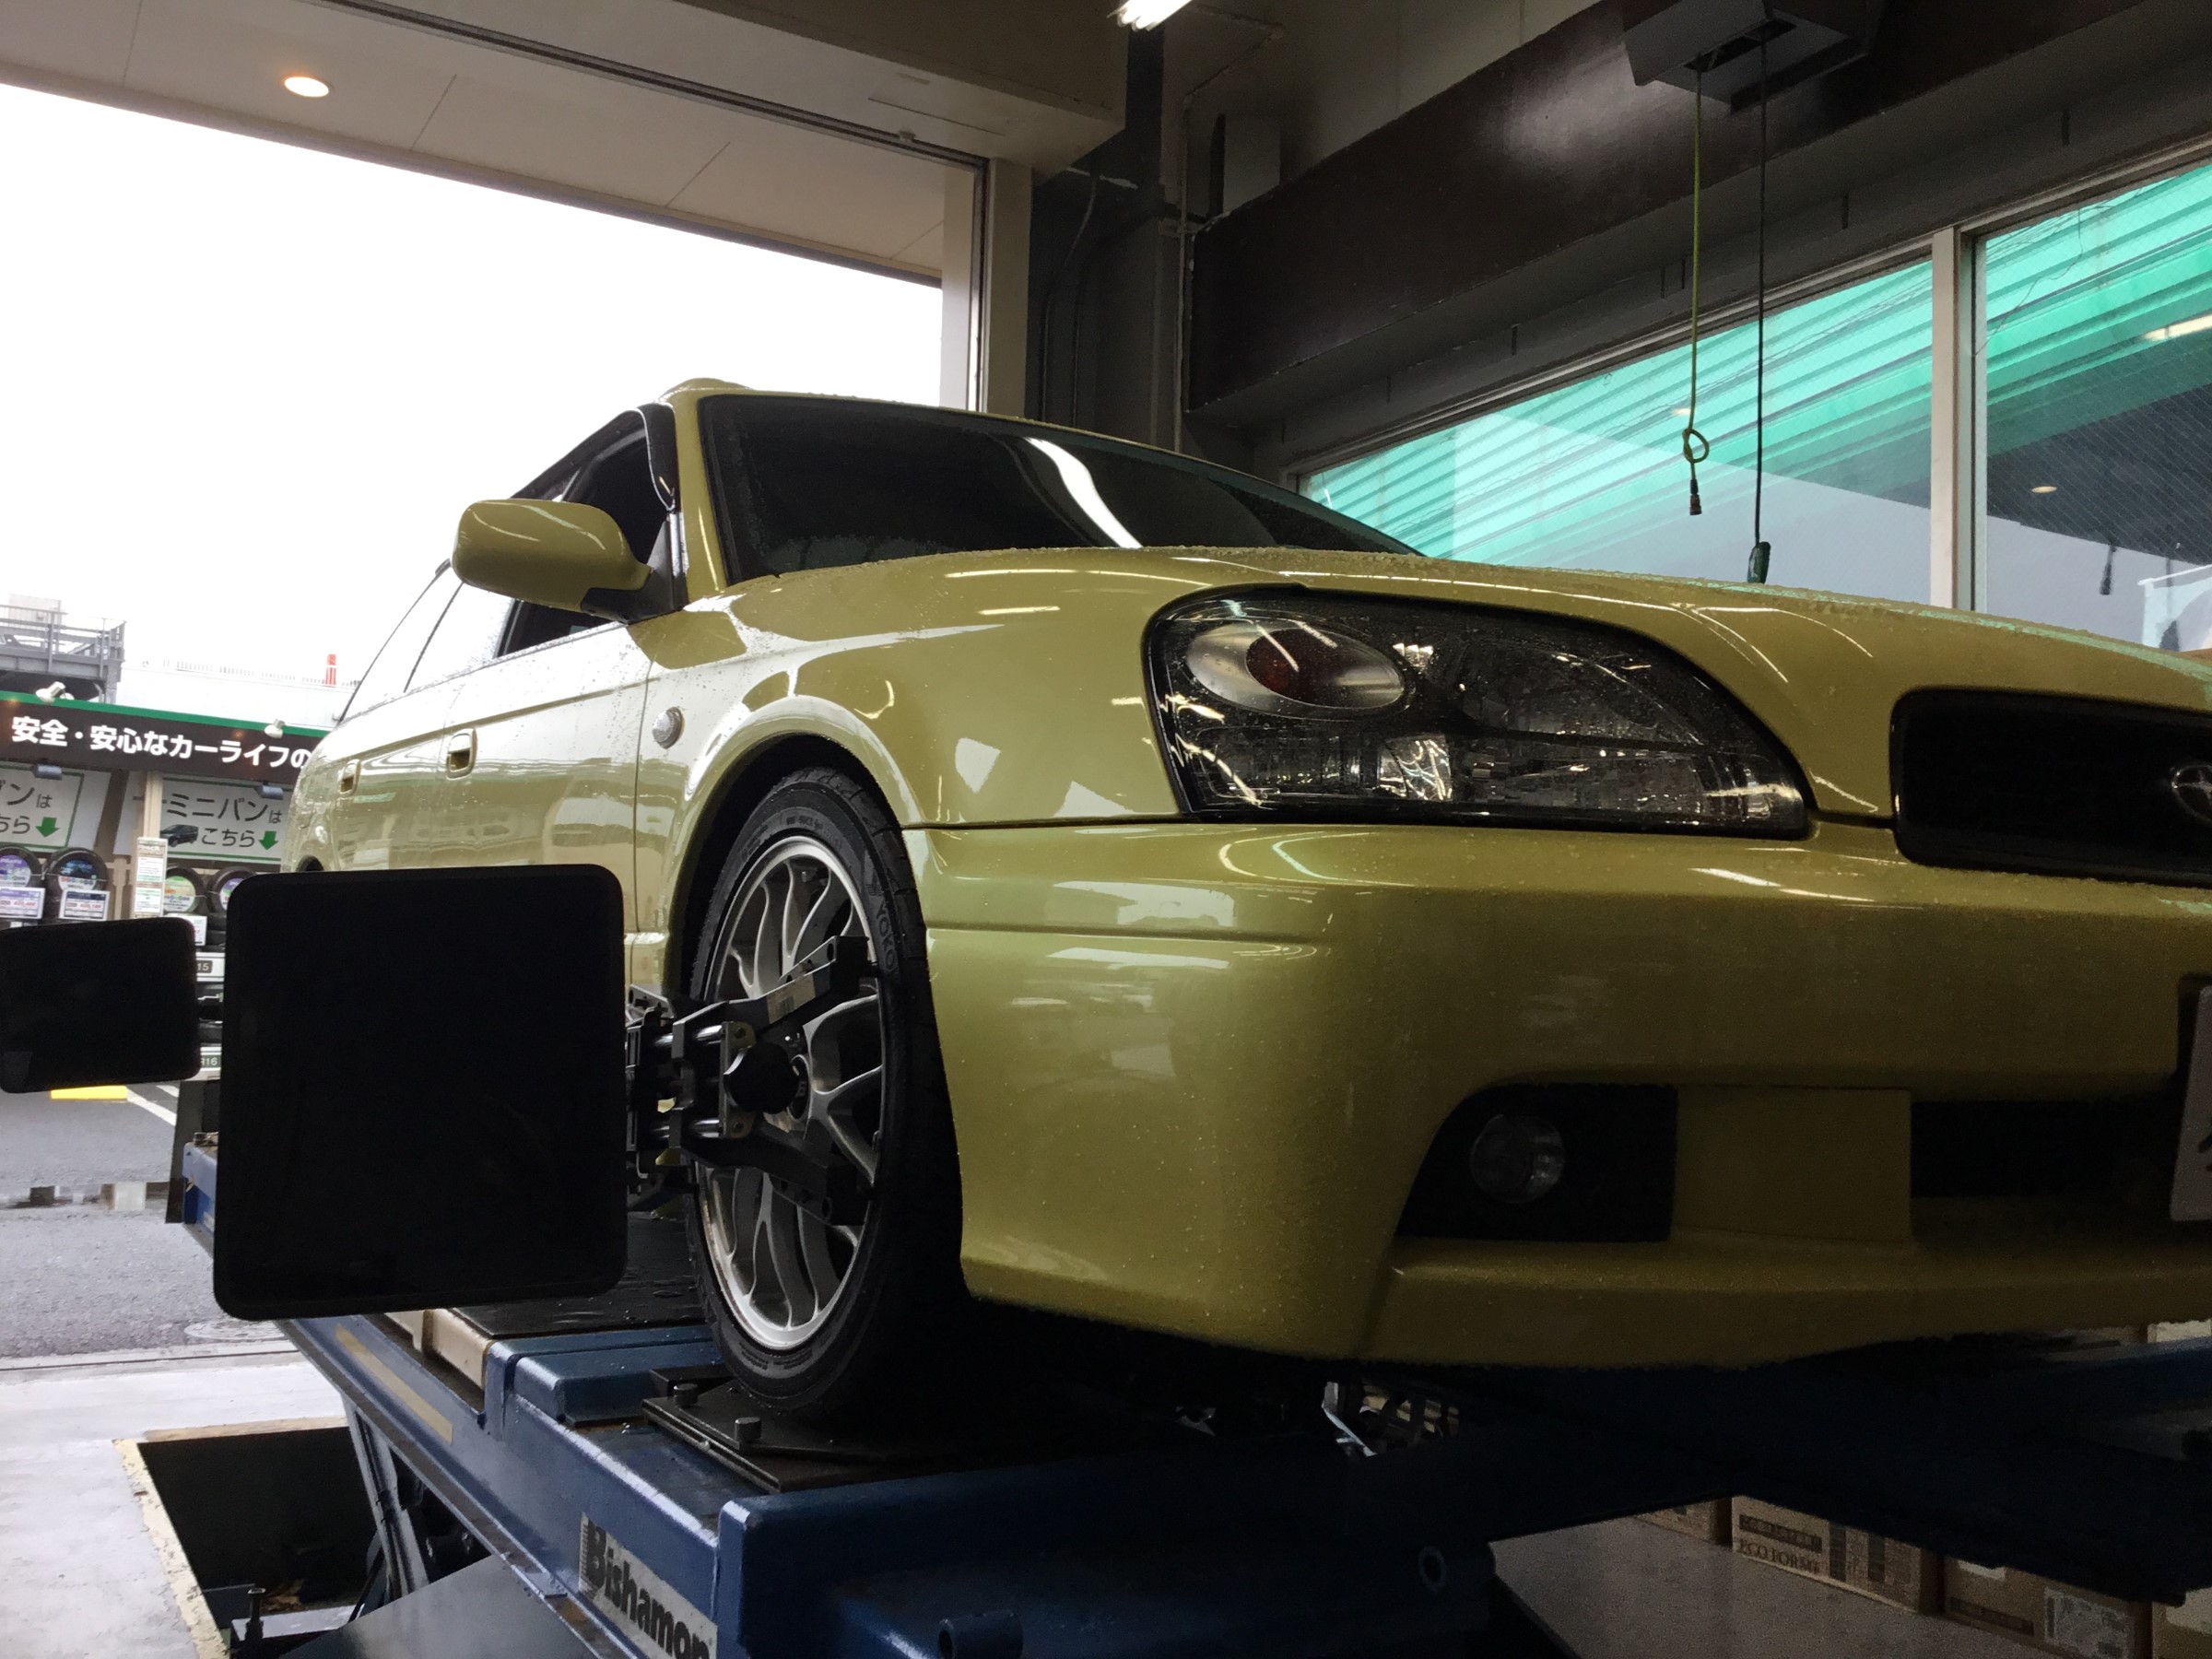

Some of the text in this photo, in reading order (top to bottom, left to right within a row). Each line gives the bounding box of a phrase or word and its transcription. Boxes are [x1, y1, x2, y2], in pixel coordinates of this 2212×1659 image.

[11, 715, 312, 770] 安全・安心なカーライフの
[166, 793, 282, 825] ミニバンは
[201, 827, 255, 848] こちら
[586, 1519, 710, 1659] Bishamon
